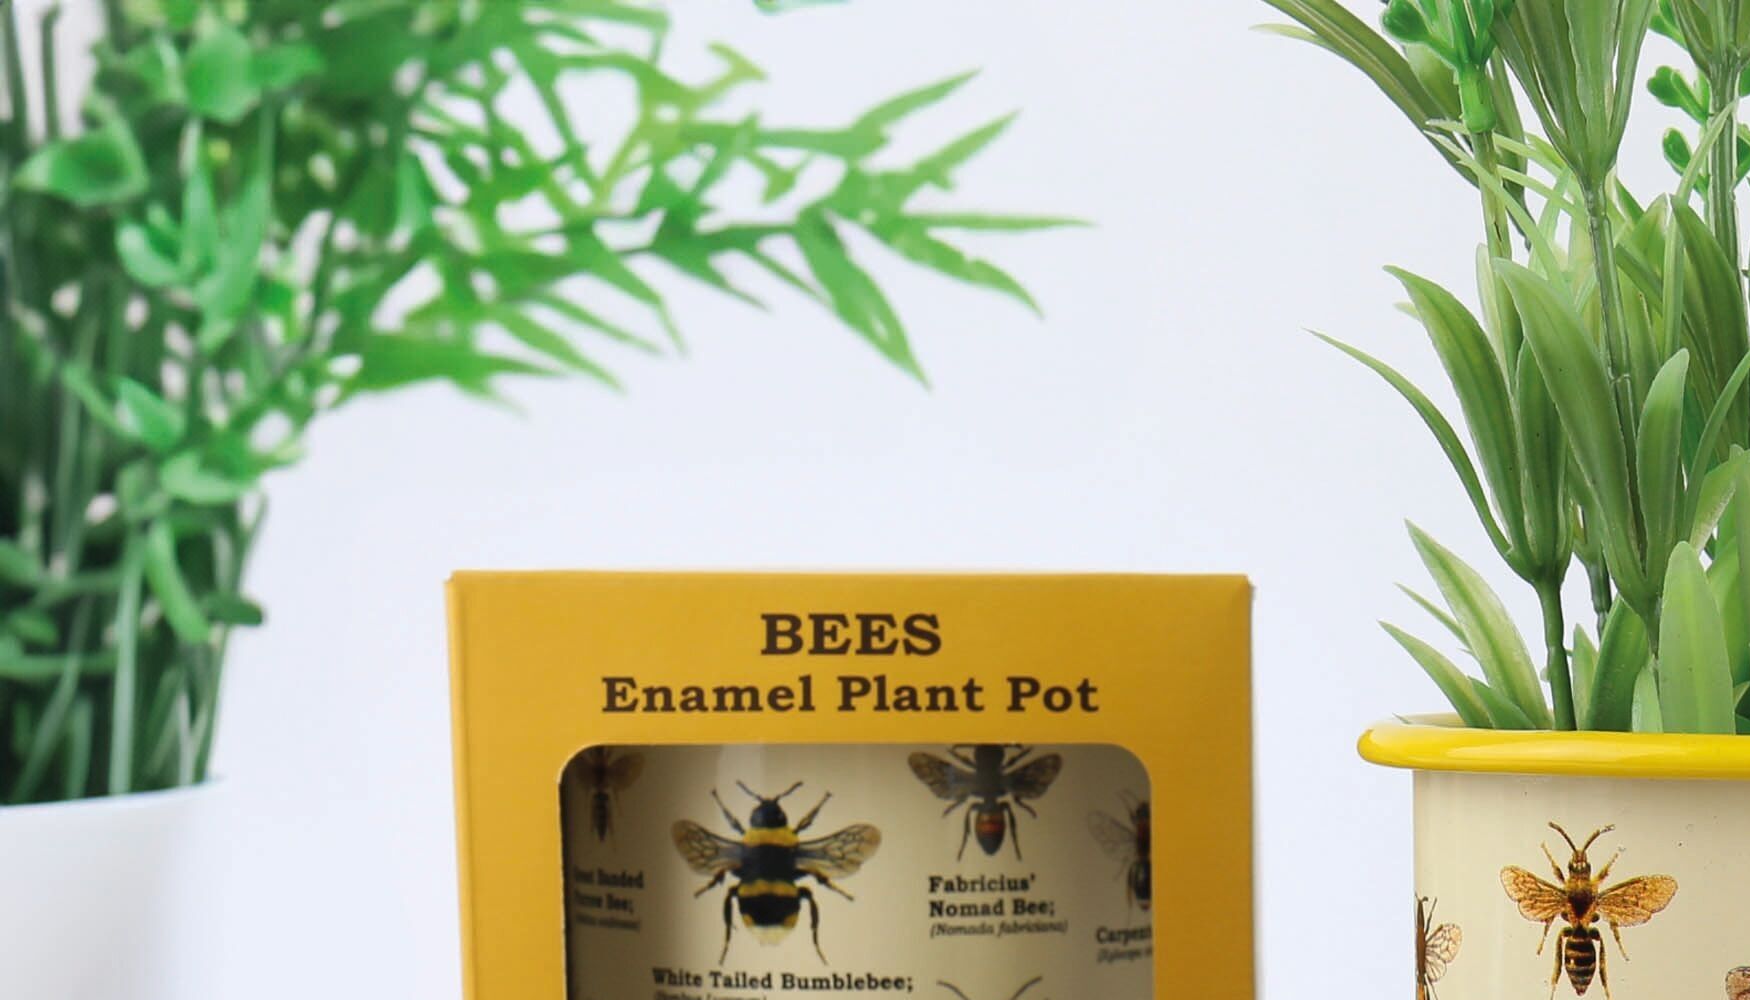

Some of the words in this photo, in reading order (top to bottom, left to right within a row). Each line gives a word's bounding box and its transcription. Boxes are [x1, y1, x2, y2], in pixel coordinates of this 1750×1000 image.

[760, 612, 942, 657] BEES
[602, 676, 814, 713] Enamel
[838, 676, 985, 712] Plant
[1007, 676, 1098, 713] Pot
[928, 873, 1035, 893] Fabricius'
[929, 899, 1004, 917] Nomad
[652, 967, 703, 986] White
[710, 970, 772, 989] Tailed
[781, 972, 914, 993] Bumblebee;
